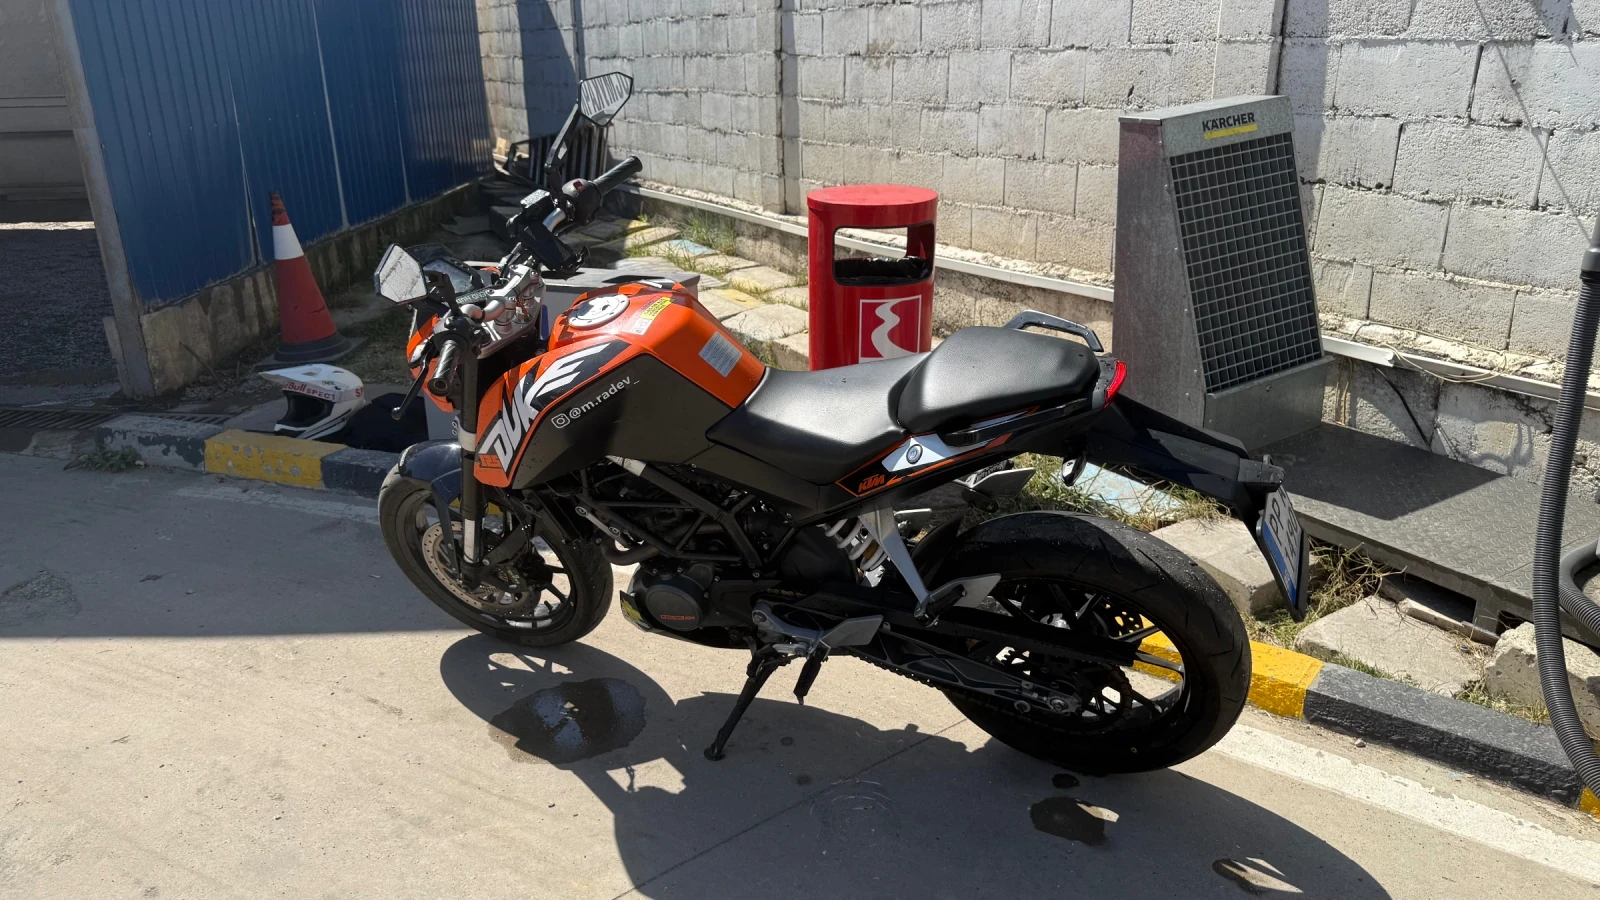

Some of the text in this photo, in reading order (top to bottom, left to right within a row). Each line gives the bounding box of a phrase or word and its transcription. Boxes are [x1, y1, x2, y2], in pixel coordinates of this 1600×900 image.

[1202, 112, 1255, 131] KÄRCHER
[478, 342, 611, 473] DUKE
[569, 375, 640, 419] @m.radev_
[858, 474, 885, 492] KTM
